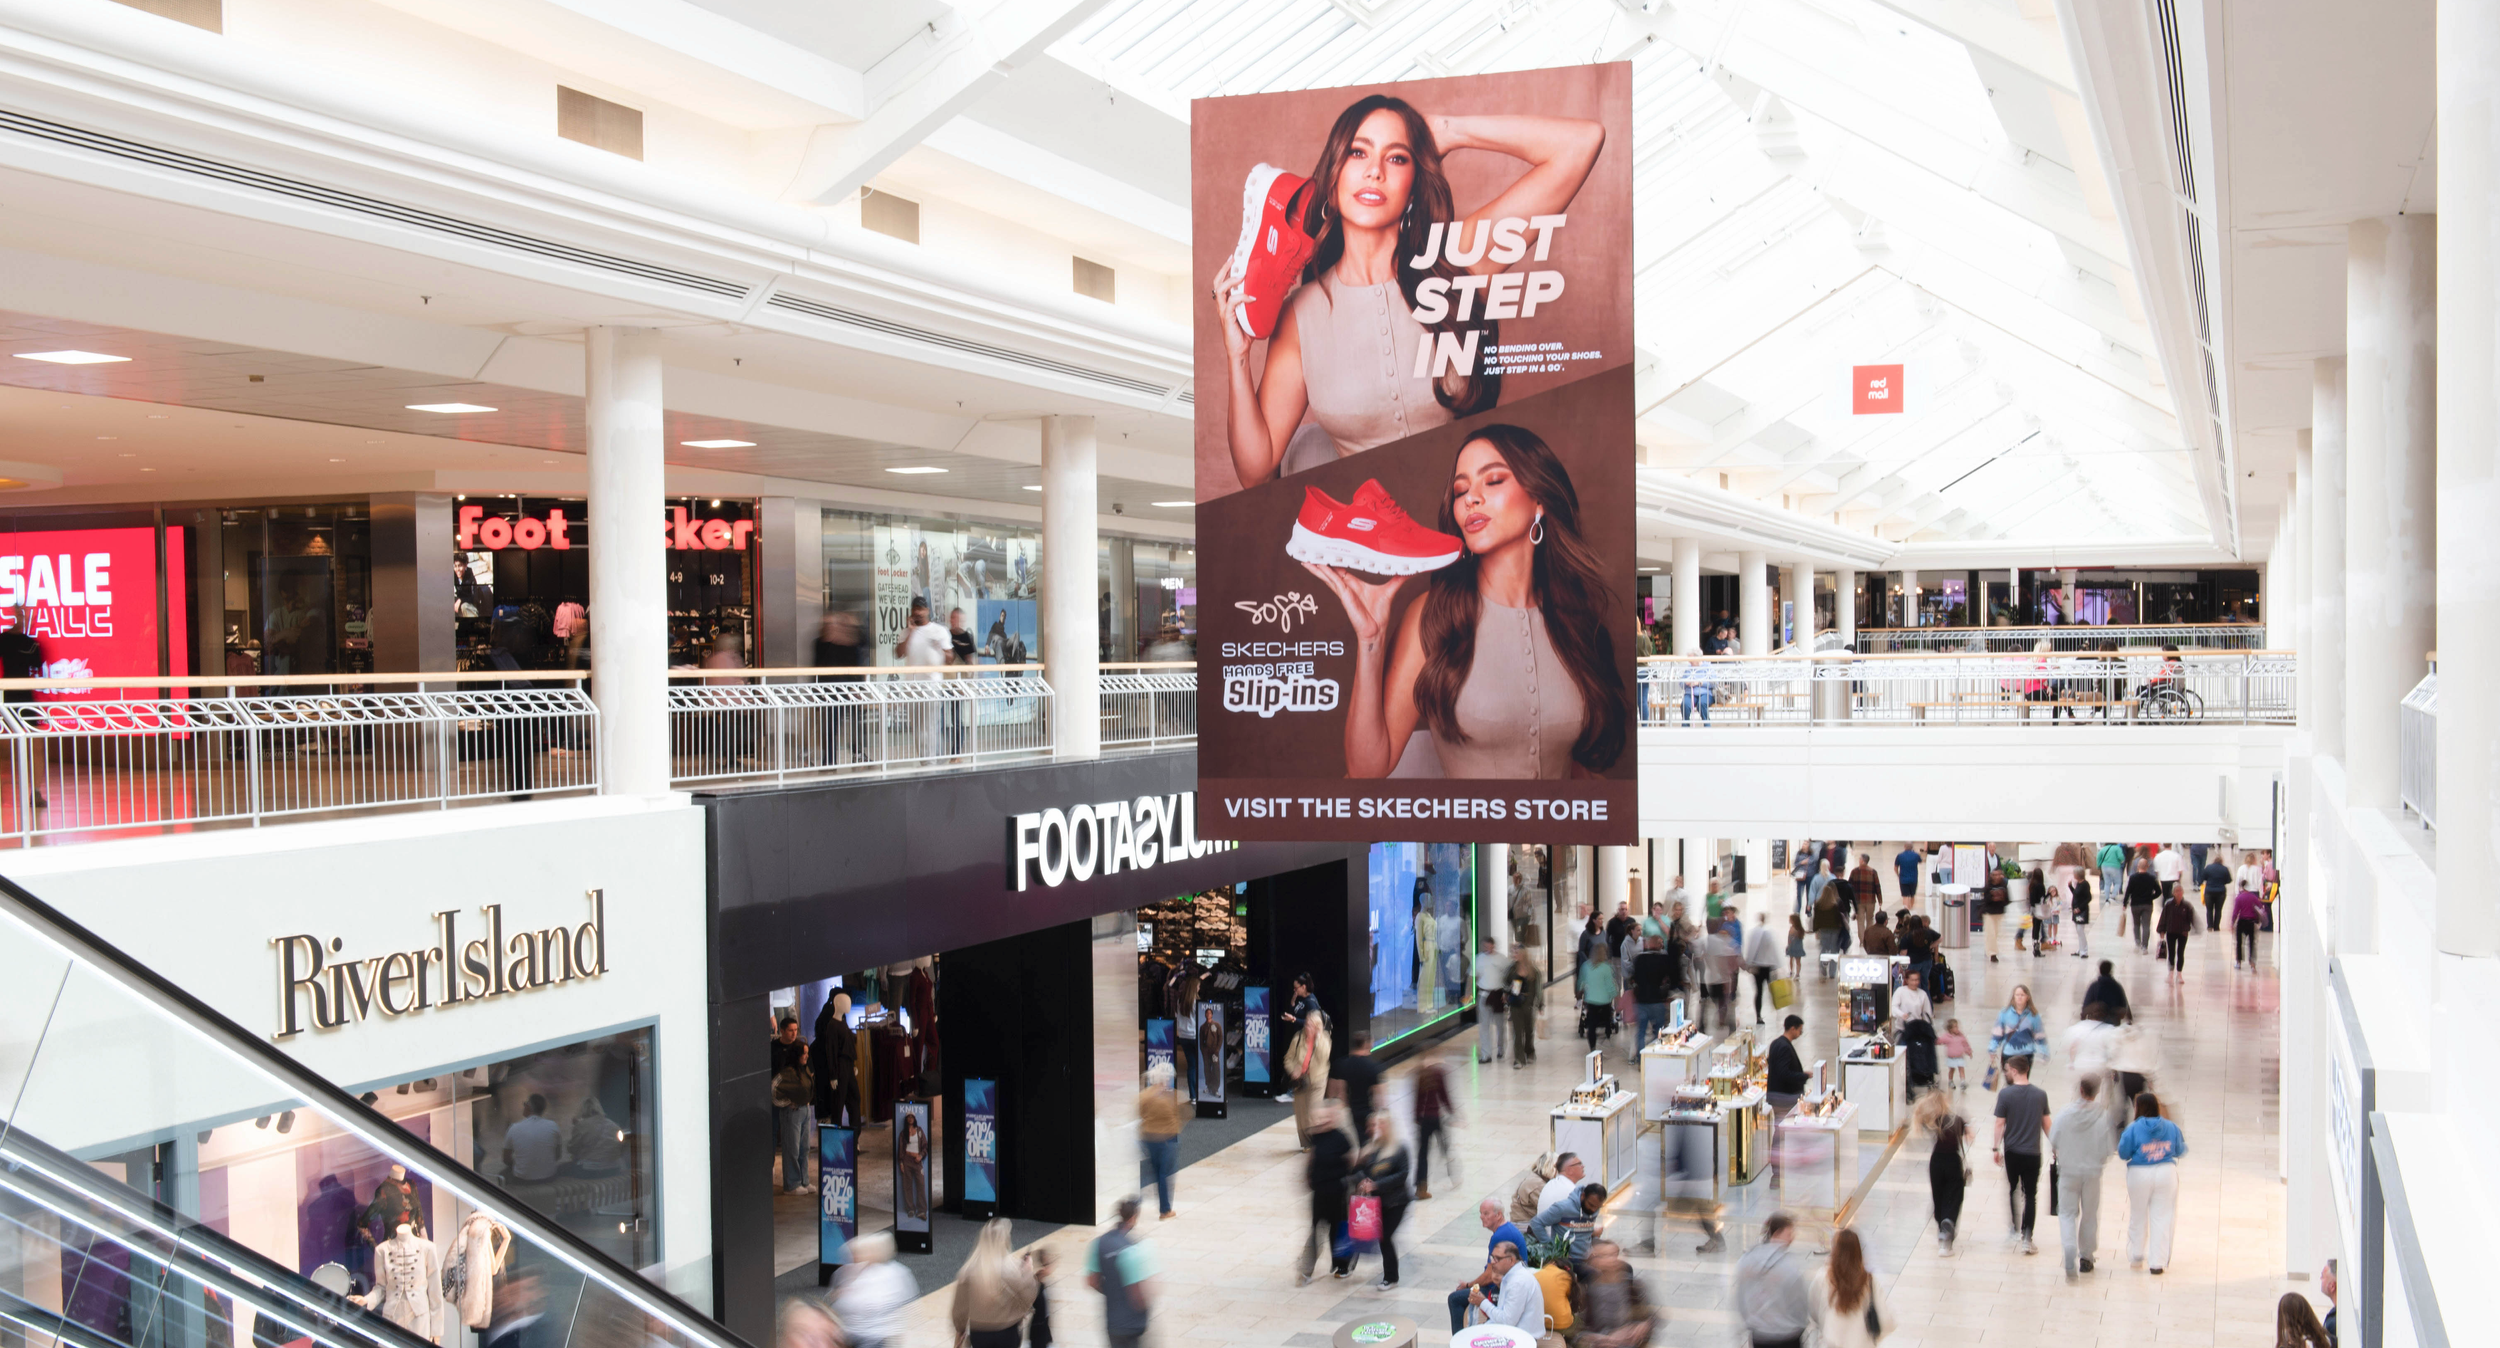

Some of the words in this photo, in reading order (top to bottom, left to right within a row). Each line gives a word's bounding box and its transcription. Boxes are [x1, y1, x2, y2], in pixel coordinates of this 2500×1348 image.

[1409, 214, 1567, 270] JUST
[1411, 270, 1565, 325] STEP
[1484, 346, 1498, 354] NO
[1498, 343, 1537, 353] BENDING
[1538, 342, 1564, 351] OVER.
[1484, 356, 1498, 365] NO
[1499, 353, 1544, 364] TOUCHING
[1545, 352, 1571, 361] YOUR
[1571, 351, 1603, 359] SHOES.
[1484, 366, 1505, 375] JUST
[1506, 365, 1527, 374] STEP
[1528, 364, 1538, 373] IN
[1539, 364, 1546, 372] &
[1870, 377, 1887, 389] red
[1868, 388, 1889, 400] mall
[459, 505, 570, 550] Foot
[0, 553, 112, 607] SALE
[877, 567, 890, 576] Foot
[891, 568, 908, 578] ocker
[877, 583, 909, 594] GATESHEAD
[897, 596, 909, 606] GOT
[879, 606, 909, 632] YOU
[1221, 641, 1345, 657] SKECHERS
[1223, 663, 1274, 678] HANDS
[1276, 662, 1314, 677] FREE
[1225, 678, 1338, 712] Slip-ins
[1224, 798, 1292, 818] VISIT
[1298, 798, 1351, 818] THE
[1358, 798, 1507, 820] SKECHERS
[1514, 799, 1608, 821] STORE
[1014, 791, 1232, 892] FOOTASYLU
[1845, 958, 1883, 977] dxb
[1201, 1003, 1221, 1012] KNITS
[1245, 1019, 1269, 1035] 20%
[1246, 1031, 1266, 1048] OFF
[899, 1104, 925, 1115] KNITS
[965, 1120, 995, 1142] 20%
[967, 1138, 991, 1158] OFF
[822, 1174, 854, 1199] 20%
[823, 1195, 850, 1216] OFF
